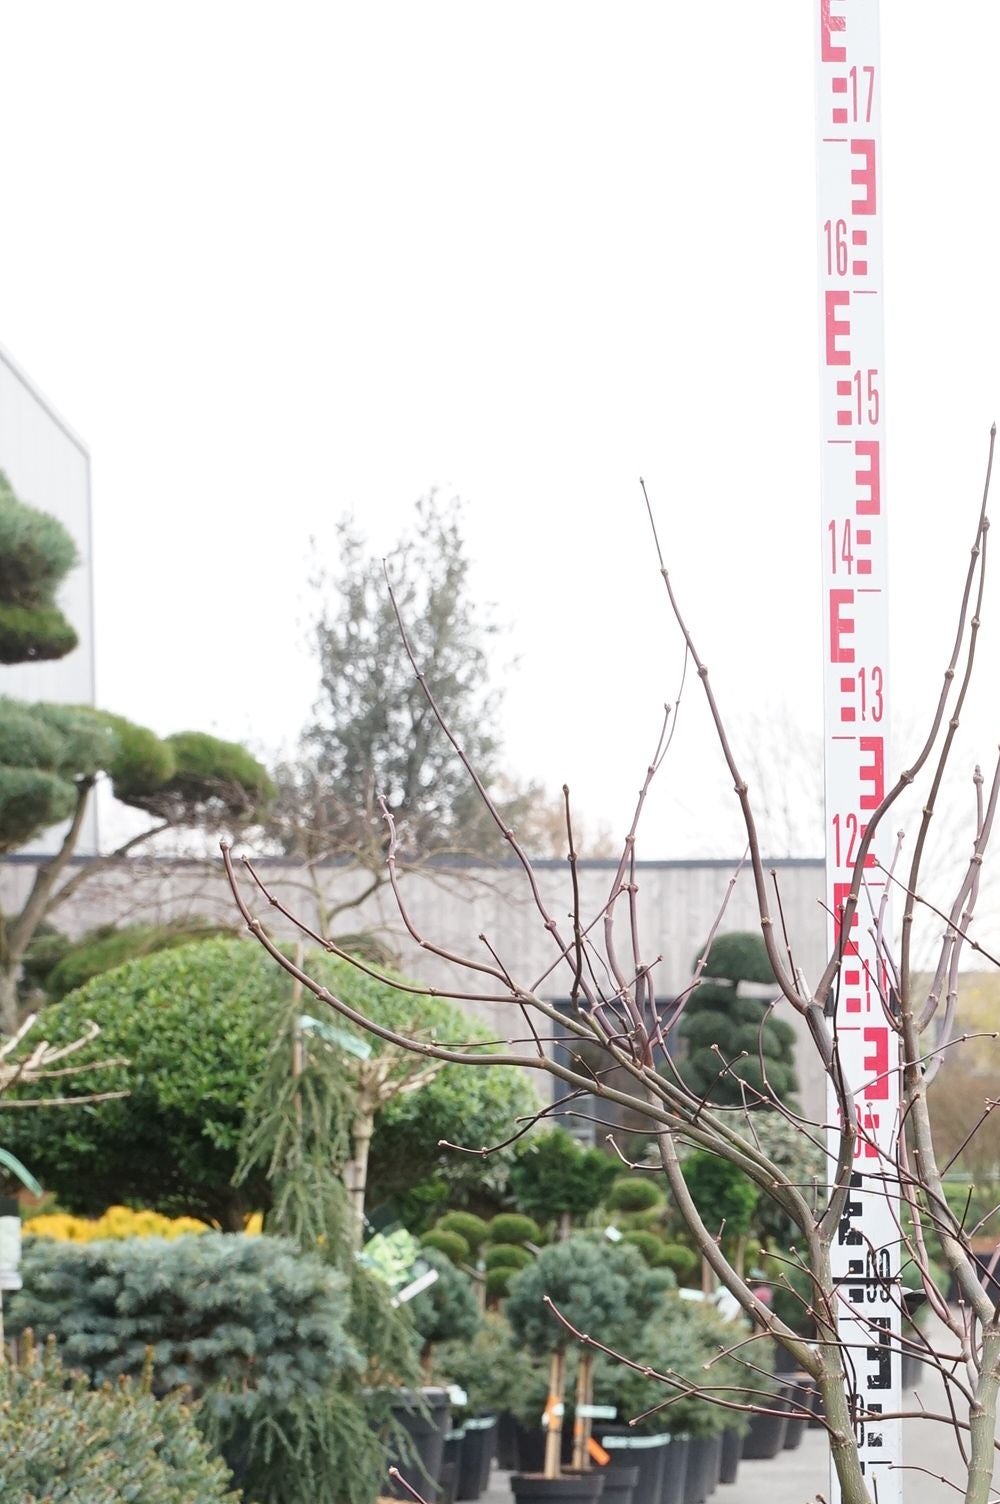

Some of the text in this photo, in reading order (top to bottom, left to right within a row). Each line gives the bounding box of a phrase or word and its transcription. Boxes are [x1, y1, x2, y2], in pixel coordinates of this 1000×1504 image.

[849, 65, 875, 123] 17
[823, 218, 848, 277] 16
[853, 369, 880, 425] 15
[828, 518, 854, 575] 14
[858, 666, 884, 722] 13
[832, 813, 859, 868] 12
